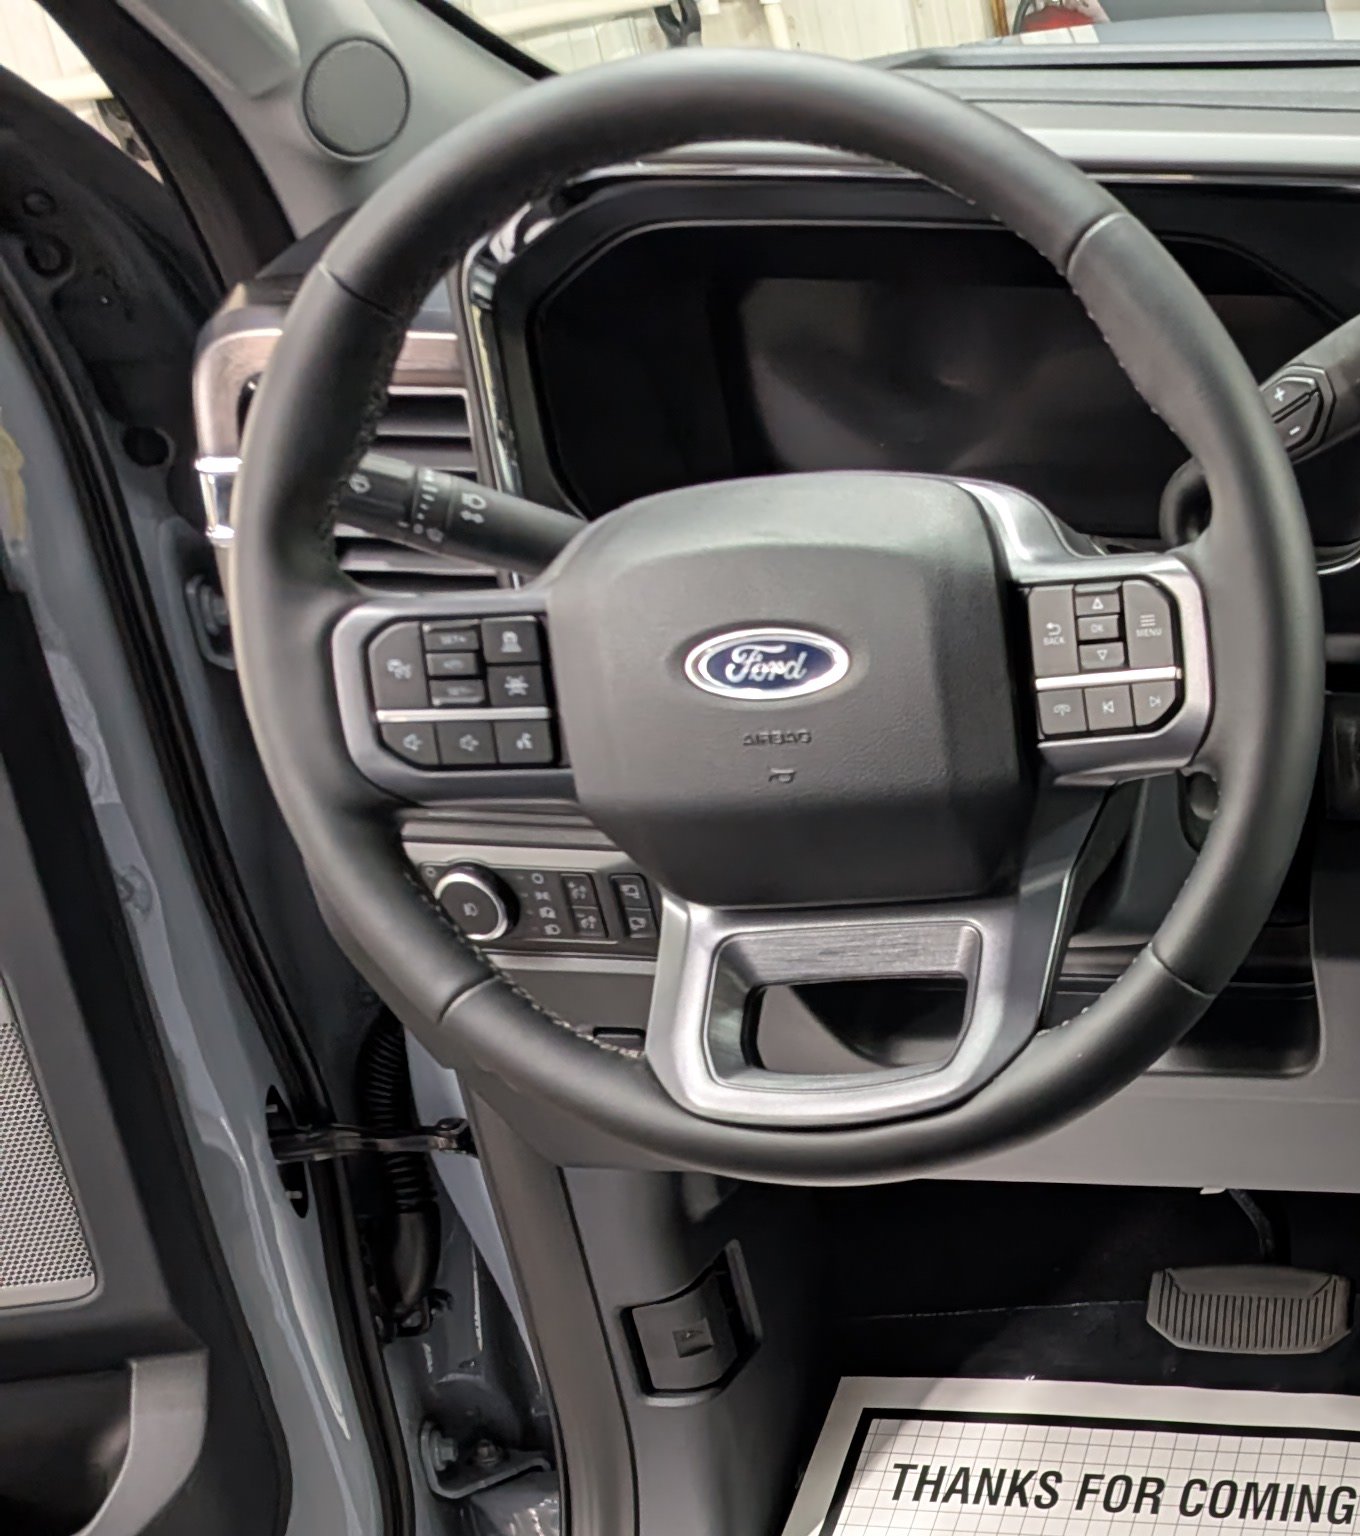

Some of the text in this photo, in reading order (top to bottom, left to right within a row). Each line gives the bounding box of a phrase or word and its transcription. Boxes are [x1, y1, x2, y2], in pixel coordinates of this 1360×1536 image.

[724, 643, 808, 683] Ford
[891, 1462, 1063, 1510] THANKS
[1075, 1473, 1166, 1515] FOR
[1179, 1477, 1359, 1526] COMING
